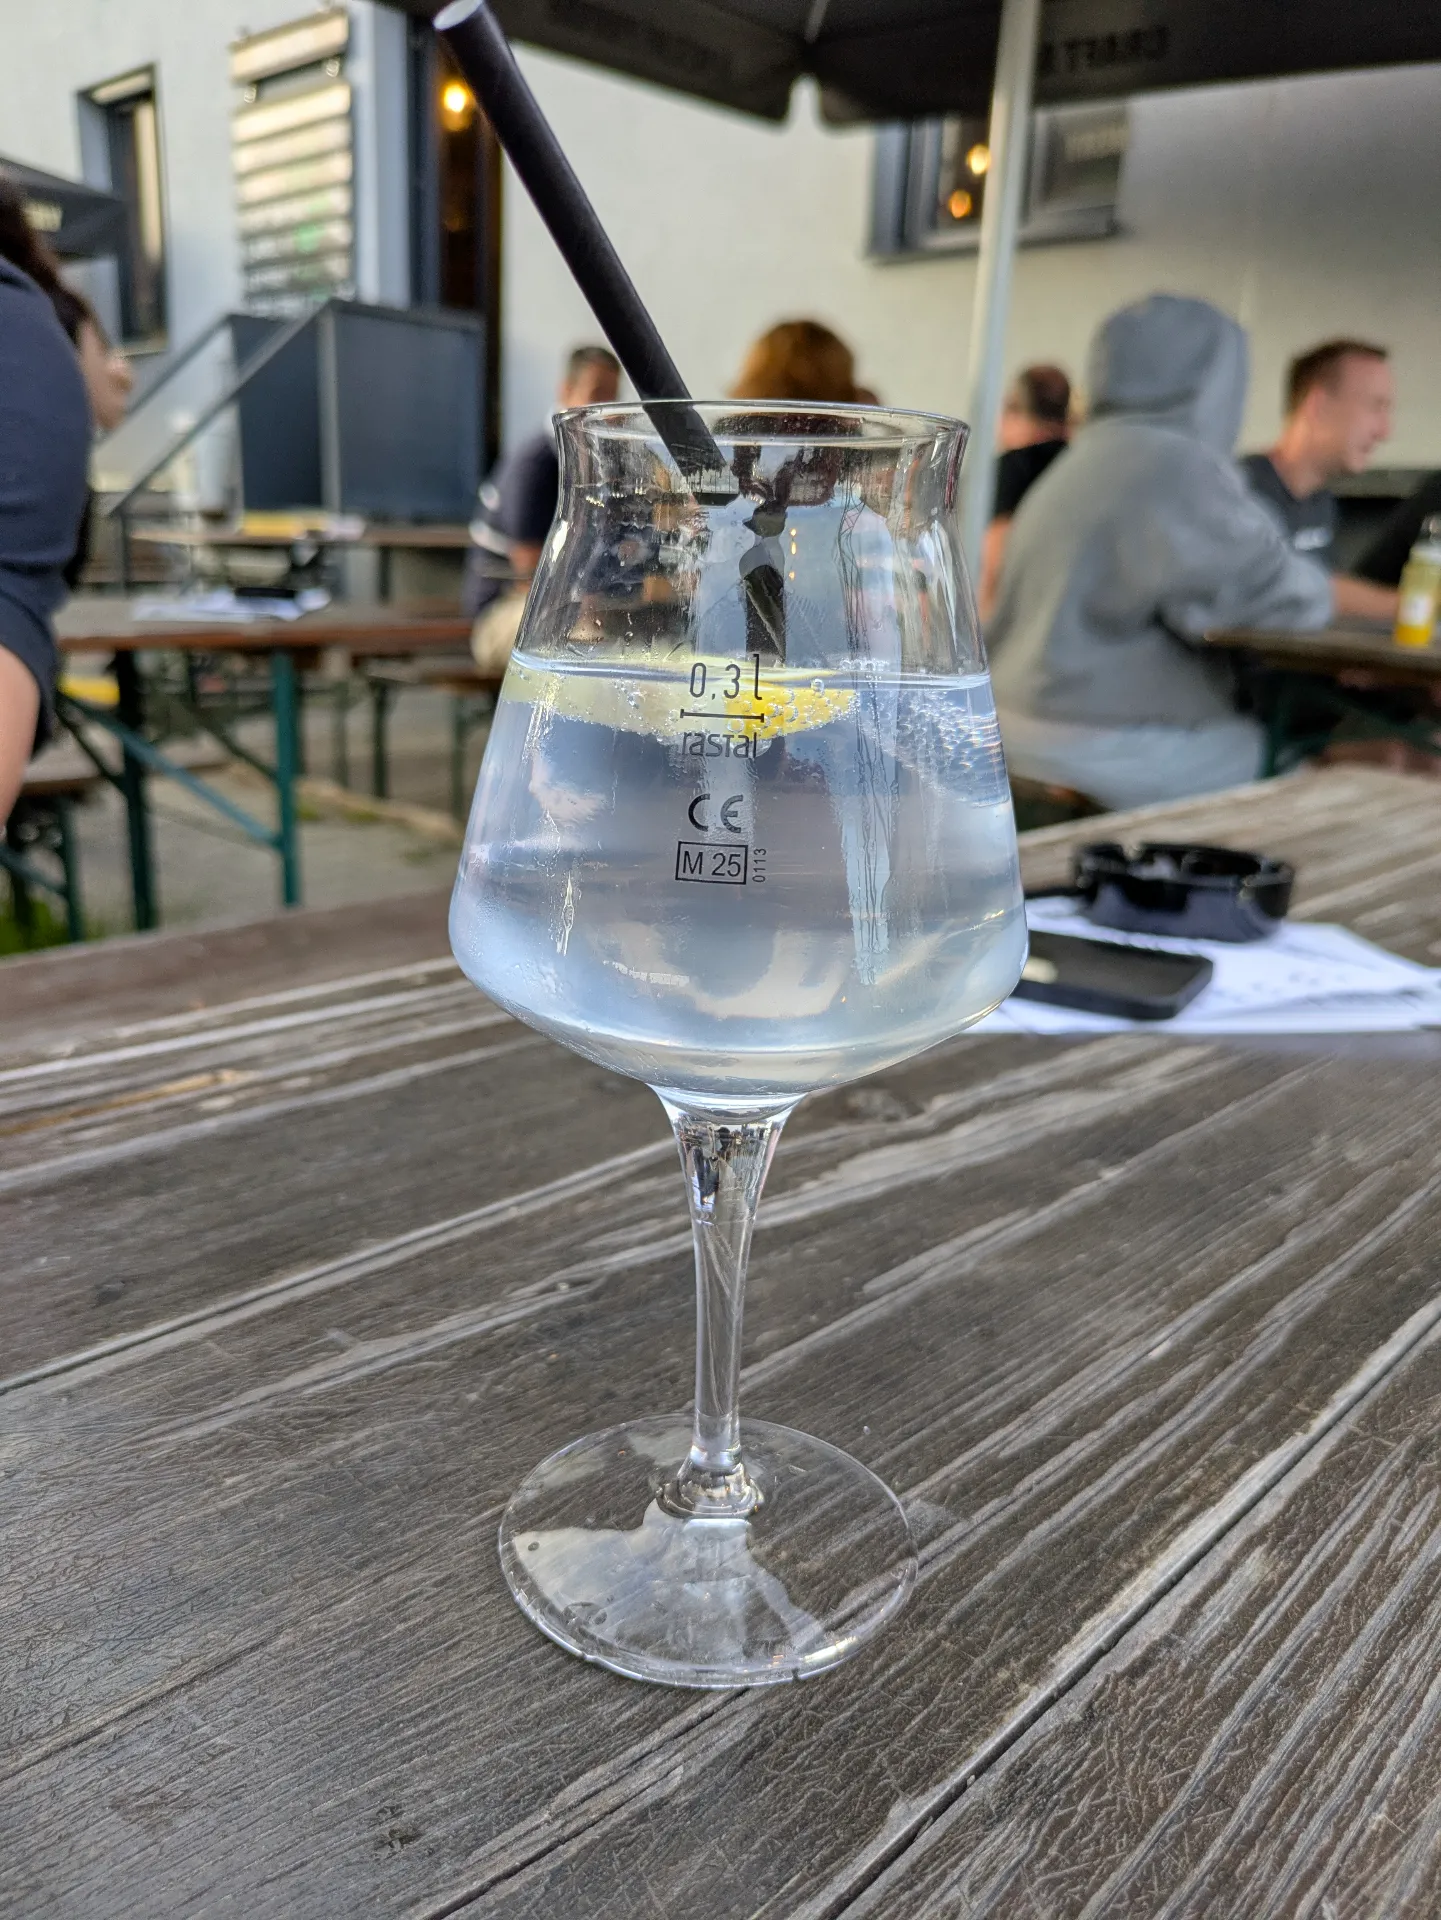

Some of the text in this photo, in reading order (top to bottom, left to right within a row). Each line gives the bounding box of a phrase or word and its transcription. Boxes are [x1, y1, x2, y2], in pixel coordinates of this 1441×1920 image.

[681, 731, 757, 759] rastal
[688, 793, 744, 834] CE
[682, 850, 741, 877] M 25
[752, 848, 767, 883] 0113
